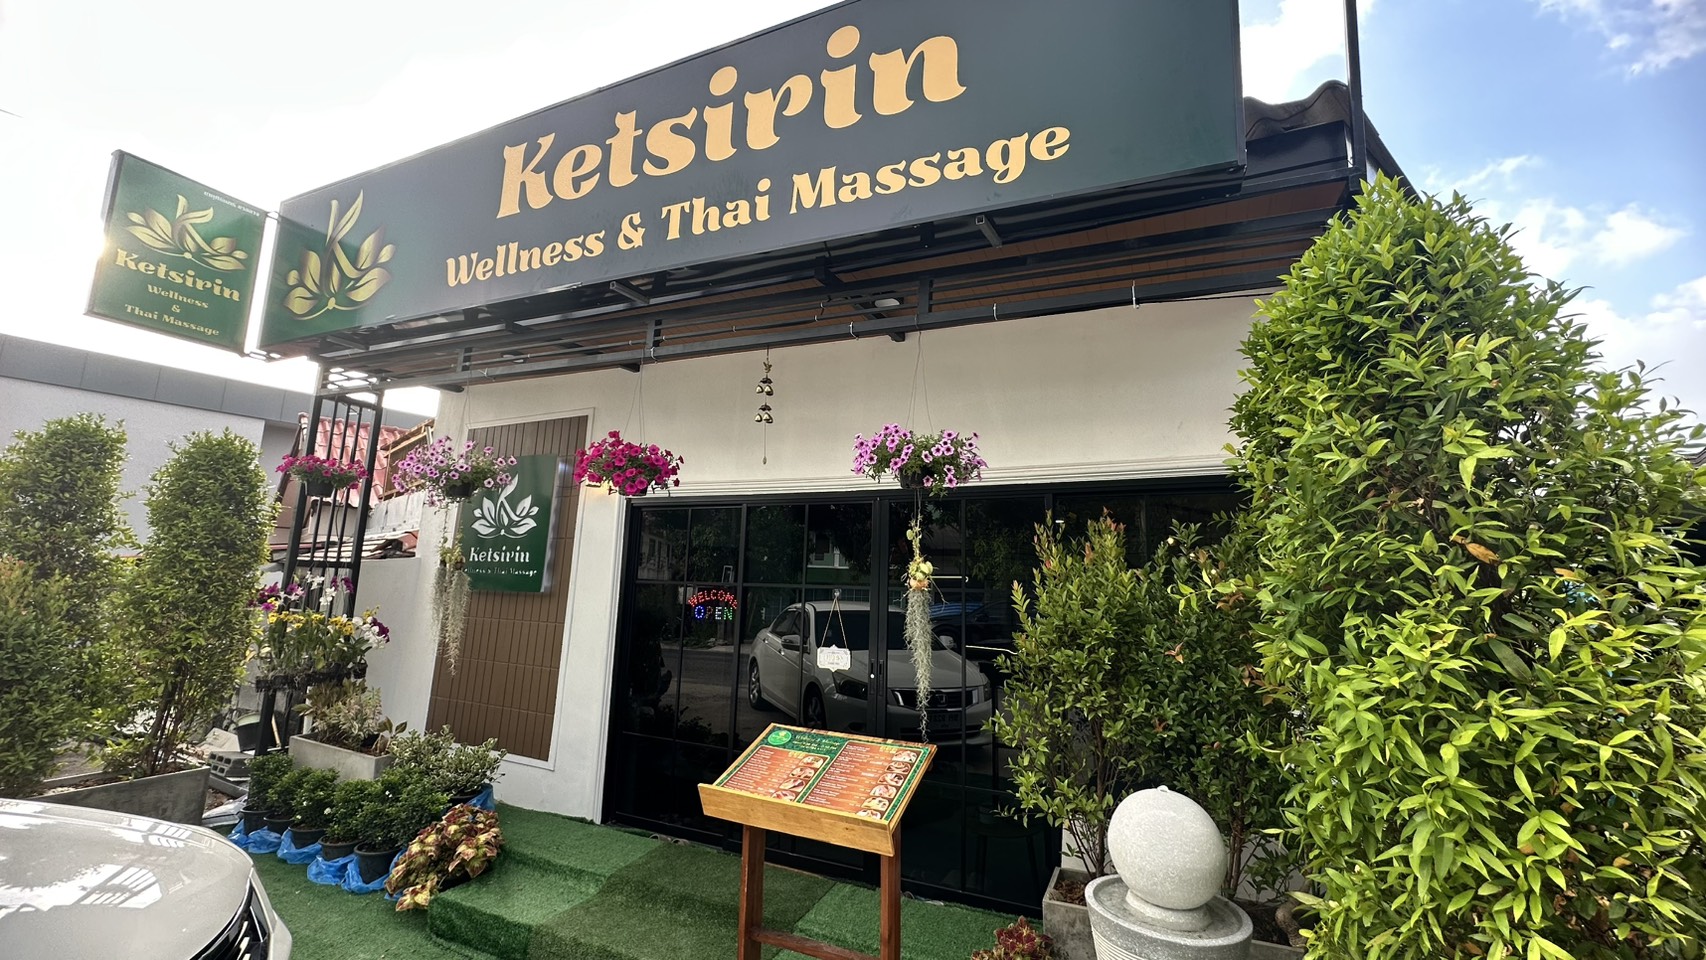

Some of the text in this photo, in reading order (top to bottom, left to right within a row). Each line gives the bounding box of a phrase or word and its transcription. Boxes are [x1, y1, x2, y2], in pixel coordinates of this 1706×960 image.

[496, 25, 967, 219] Ketsirin
[446, 125, 1071, 288] Wellness & Thai Massage
[115, 248, 240, 302] Ketsirin
[147, 284, 209, 309] Wellness
[171, 304, 181, 313] &
[124, 303, 220, 336] Thai Massage
[469, 545, 530, 563] Ketsirin
[688, 589, 738, 610] WELCOME
[694, 605, 733, 620] OPEN
